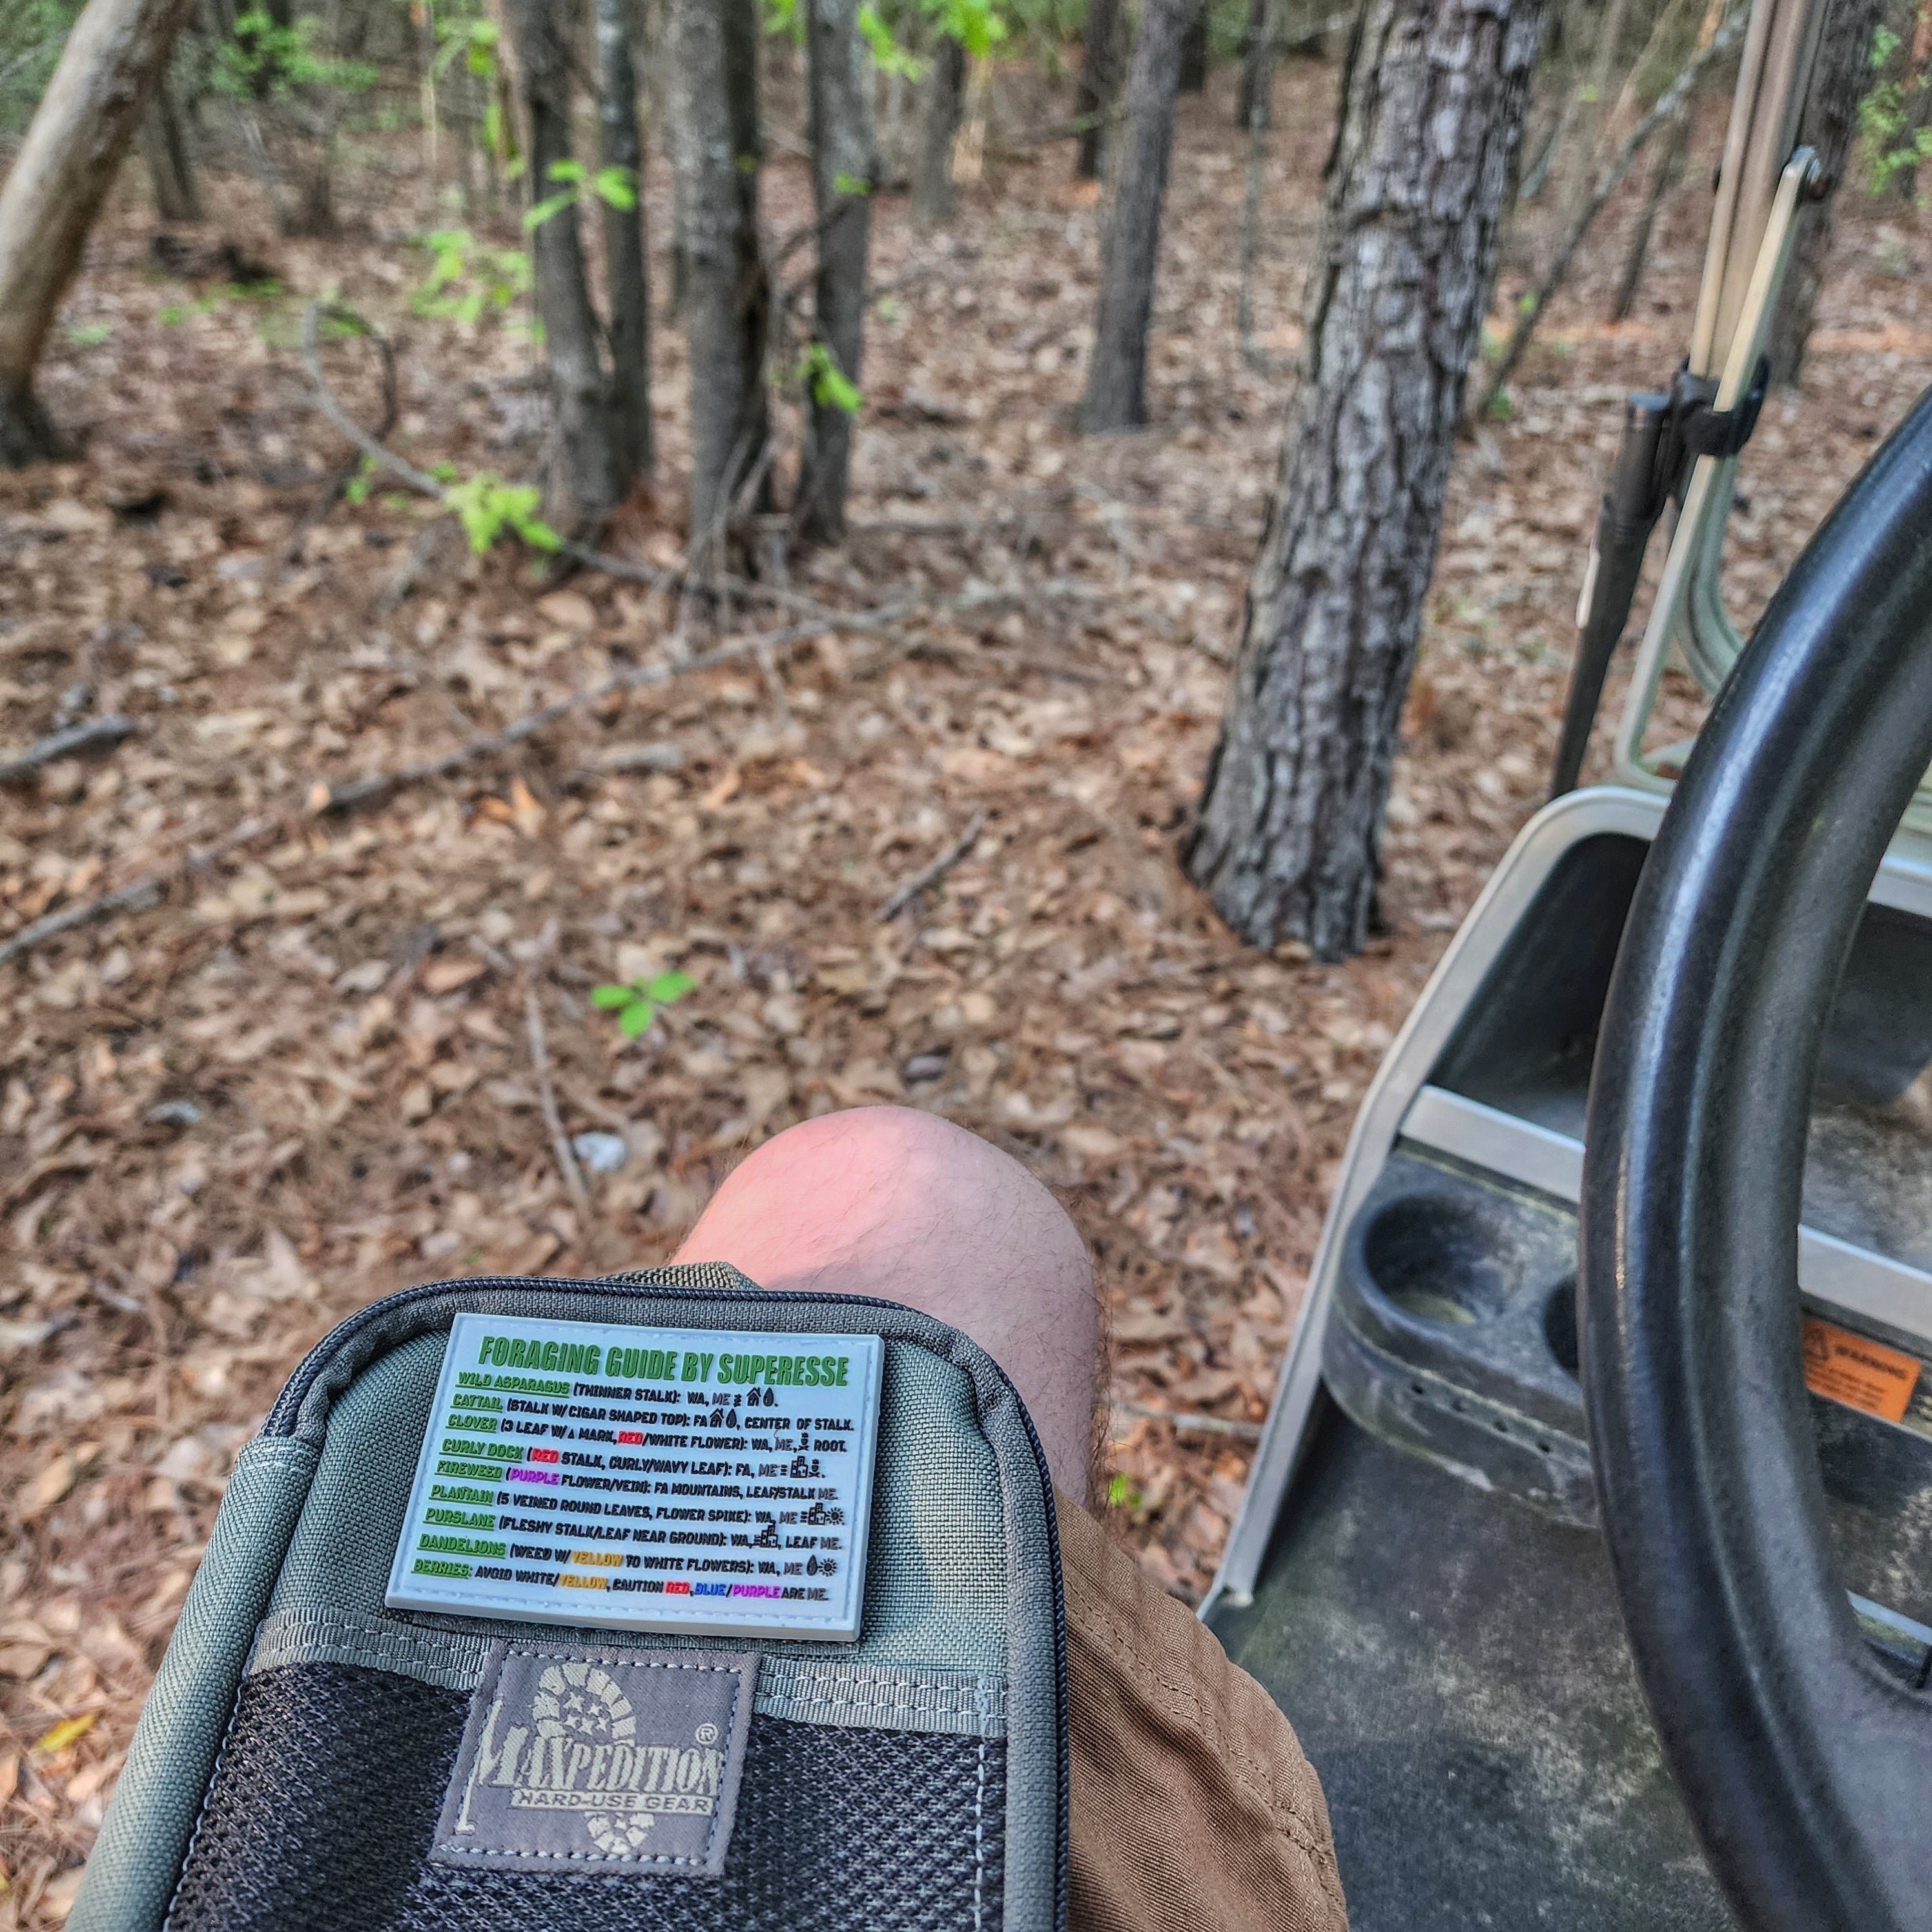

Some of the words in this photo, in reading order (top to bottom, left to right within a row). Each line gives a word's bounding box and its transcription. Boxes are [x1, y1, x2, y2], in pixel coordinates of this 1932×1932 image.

[478, 1336, 601, 1375] FORAGING
[604, 1346, 677, 1381] GUIDE
[681, 1352, 714, 1382] BY
[717, 1353, 848, 1386] SUPERESSE
[458, 1372, 491, 1388] WILD
[494, 1375, 570, 1395] ASPARAGUS
[573, 1382, 632, 1400] (THINNER
[635, 1388, 681, 1404] STALK):
[687, 1391, 709, 1406] WA,
[712, 1393, 731, 1405] ME
[453, 1393, 502, 1410] CATTAIL
[507, 1398, 550, 1415] (STALK
[569, 1406, 606, 1420] CIGAR
[609, 1409, 657, 1424] SHAPED
[661, 1413, 690, 1426] TOP):
[693, 1415, 707, 1426] FA
[745, 1417, 790, 1430] CENTER
[796, 1418, 812, 1430] OF
[814, 1418, 855, 1431] STALK.
[448, 1414, 497, 1431] CLOVER
[501, 1419, 513, 1432] (3
[516, 1421, 548, 1435] LEAF
[690, 1435, 748, 1451] FLOWER):
[751, 1438, 773, 1453] WA,
[814, 1439, 847, 1452] ROOT.
[442, 1439, 485, 1455] CURLY
[488, 1443, 524, 1461] DOCK
[526, 1446, 558, 1463] (RED
[561, 1452, 605, 1470] STALK,
[609, 1455, 688, 1474] CURLY/WAVY
[691, 1461, 732, 1477] LEAF):
[735, 1463, 755, 1479] FA,
[759, 1464, 777, 1477] ME
[437, 1461, 502, 1479] FIREWEED
[506, 1467, 559, 1485] (PURPLE
[561, 1474, 650, 1494] FLOWER/VEIN):
[654, 1482, 668, 1494] FA
[671, 1483, 743, 1500] MOUNTAINS,
[746, 1486, 816, 1499] LEAF/STALK
[818, 1488, 838, 1499] ME.
[431, 1485, 494, 1505] PLANTAIN
[497, 1491, 509, 1505] (5
[513, 1494, 557, 1510] VEINED
[560, 1499, 601, 1514] ROUND
[604, 1503, 652, 1520] LEAVES,
[656, 1506, 705, 1521] FLOWER
[708, 1510, 752, 1523] SPIKE):
[779, 1512, 798, 1524] ME
[426, 1508, 496, 1529] PURSLANE
[498, 1516, 553, 1534] (FLESHY
[555, 1522, 631, 1541] STALK/LEAF
[633, 1529, 666, 1543] NEAR
[670, 1532, 726, 1547] GROUND):
[785, 1536, 817, 1548] LEAF
[820, 1537, 842, 1550] ME.
[420, 1534, 506, 1557] DANDELIONS
[510, 1543, 552, 1560] (WEED
[572, 1551, 623, 1567] YELLOW
[626, 1555, 640, 1568] TO
[644, 1556, 684, 1570] WHITE
[686, 1558, 754, 1574] FLOWERS):
[758, 1561, 780, 1576] WA,
[783, 1562, 803, 1575] ME
[414, 1559, 473, 1577] BERRIES:
[475, 1566, 512, 1580] AVOID
[613, 1579, 663, 1593] CAUTION
[781, 1587, 805, 1599] ARE
[807, 1588, 829, 1601] ME.
[518, 1792, 637, 1809] HARD-USE
[646, 1795, 711, 1813] GEAR
